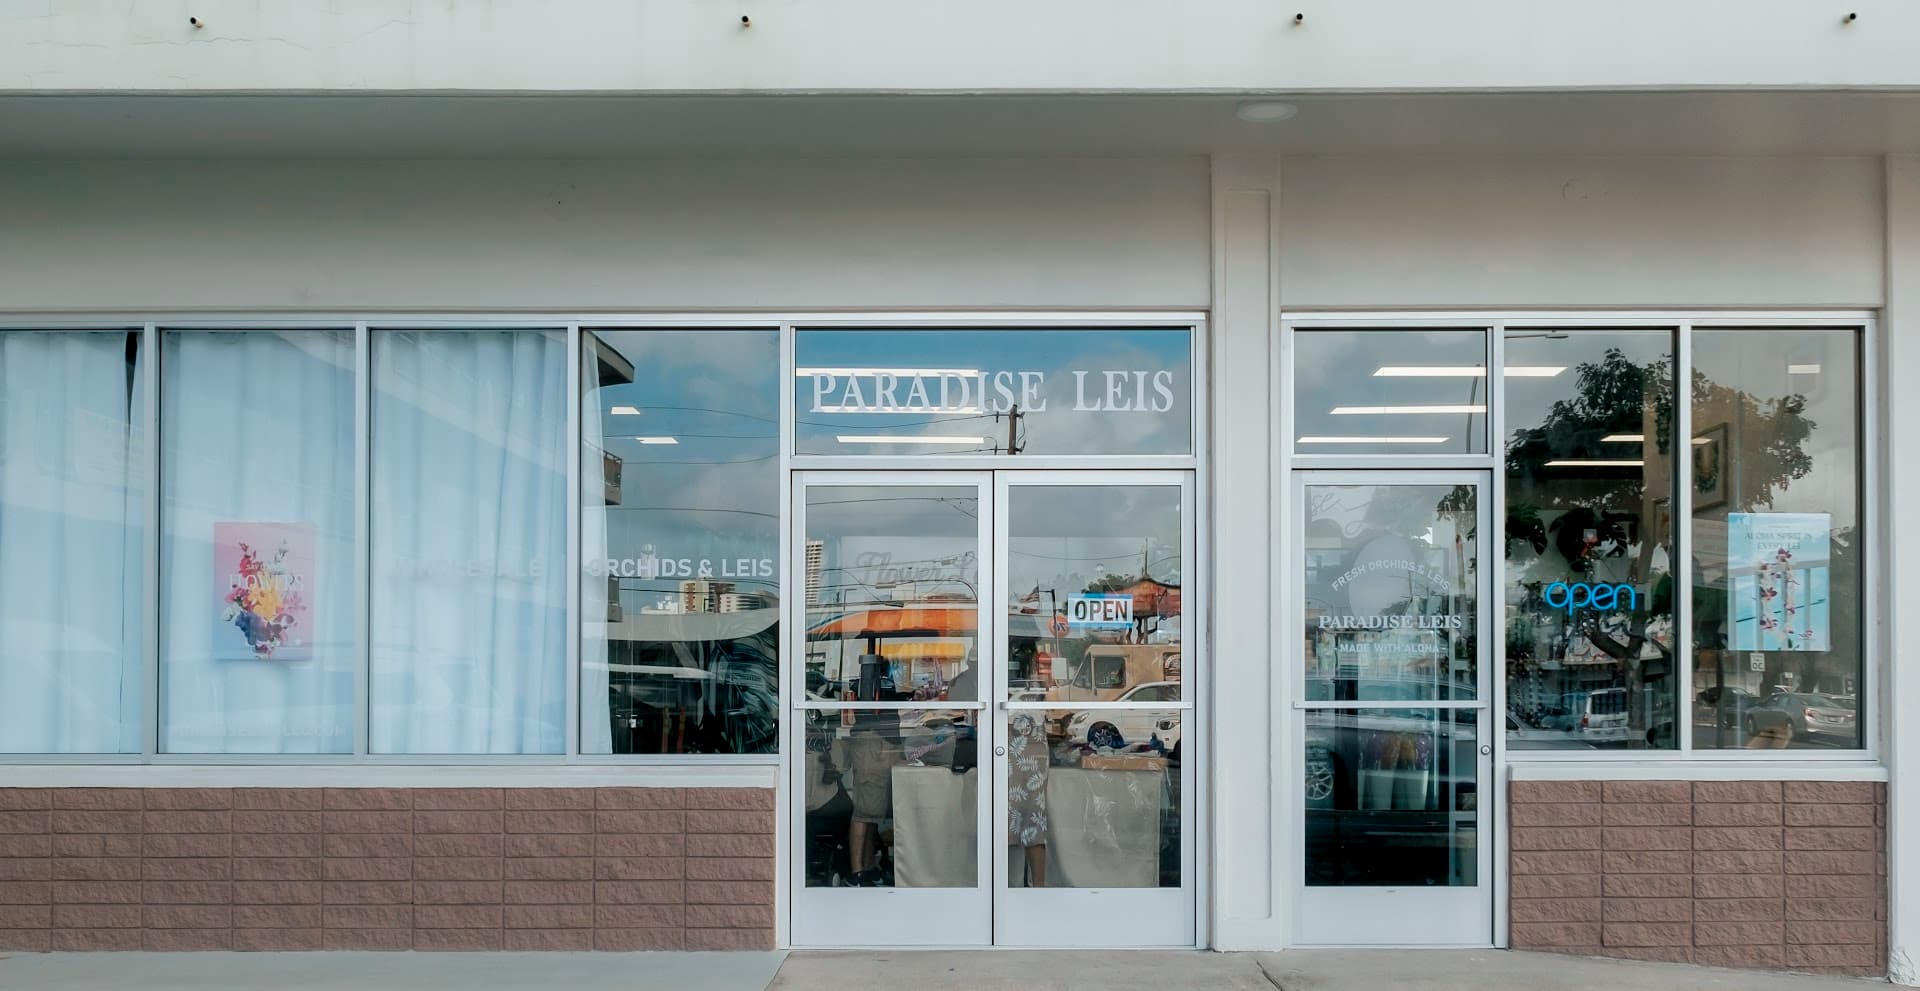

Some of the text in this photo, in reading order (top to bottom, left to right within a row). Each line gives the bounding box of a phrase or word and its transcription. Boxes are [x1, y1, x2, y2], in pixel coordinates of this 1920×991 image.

[809, 370, 1174, 413] PARADISE LEIS
[589, 558, 692, 577] ORCHIDS
[697, 558, 713, 577] &
[721, 558, 773, 577] LEIS
[1331, 565, 1366, 591] FRESH
[1368, 559, 1416, 572] ORCHIDS
[1427, 569, 1451, 591] LEIS
[1074, 600, 1128, 621] OPEN
[1318, 615, 1462, 629] PARADISE LEIS
[1339, 643, 1439, 653] MADE WITH ALOHA
